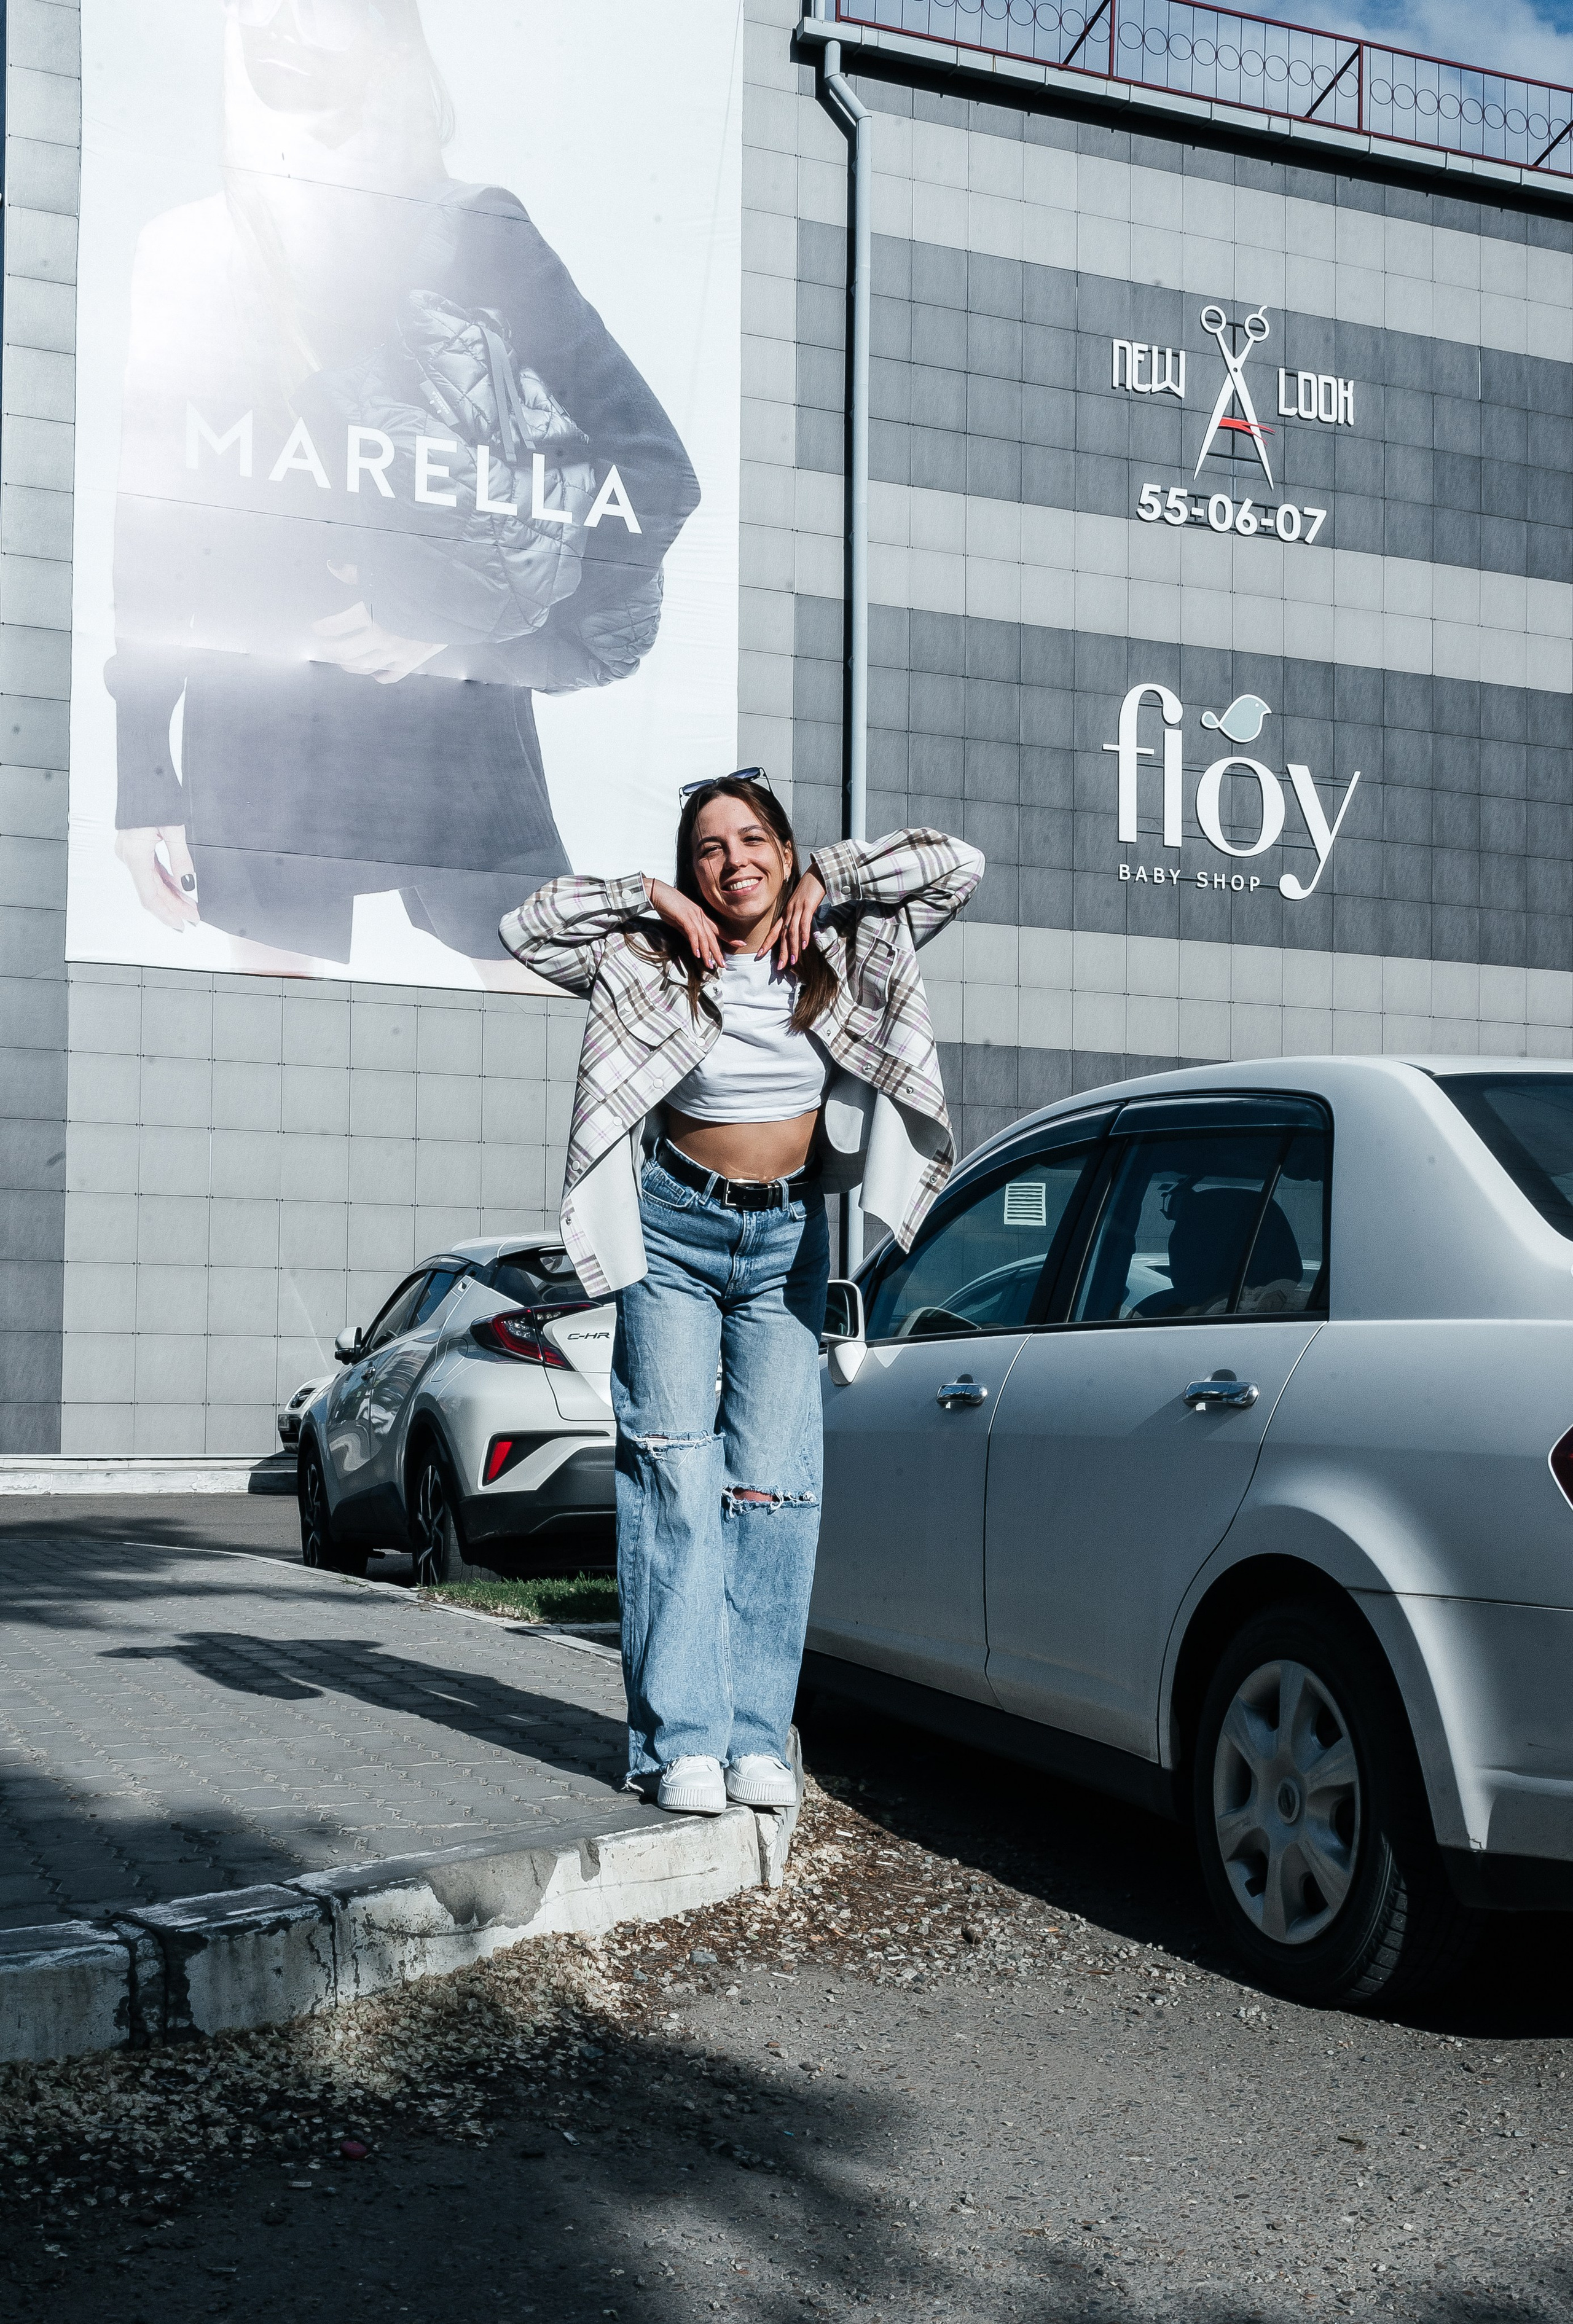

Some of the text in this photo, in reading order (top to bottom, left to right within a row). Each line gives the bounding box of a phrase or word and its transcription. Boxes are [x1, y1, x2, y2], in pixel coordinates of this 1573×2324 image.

[1112, 338, 1354, 426] NEW LOOK
[186, 401, 643, 534] MARELLA
[1137, 483, 1327, 544] 55-06-07
[1119, 864, 1261, 891] BABY SHOP
